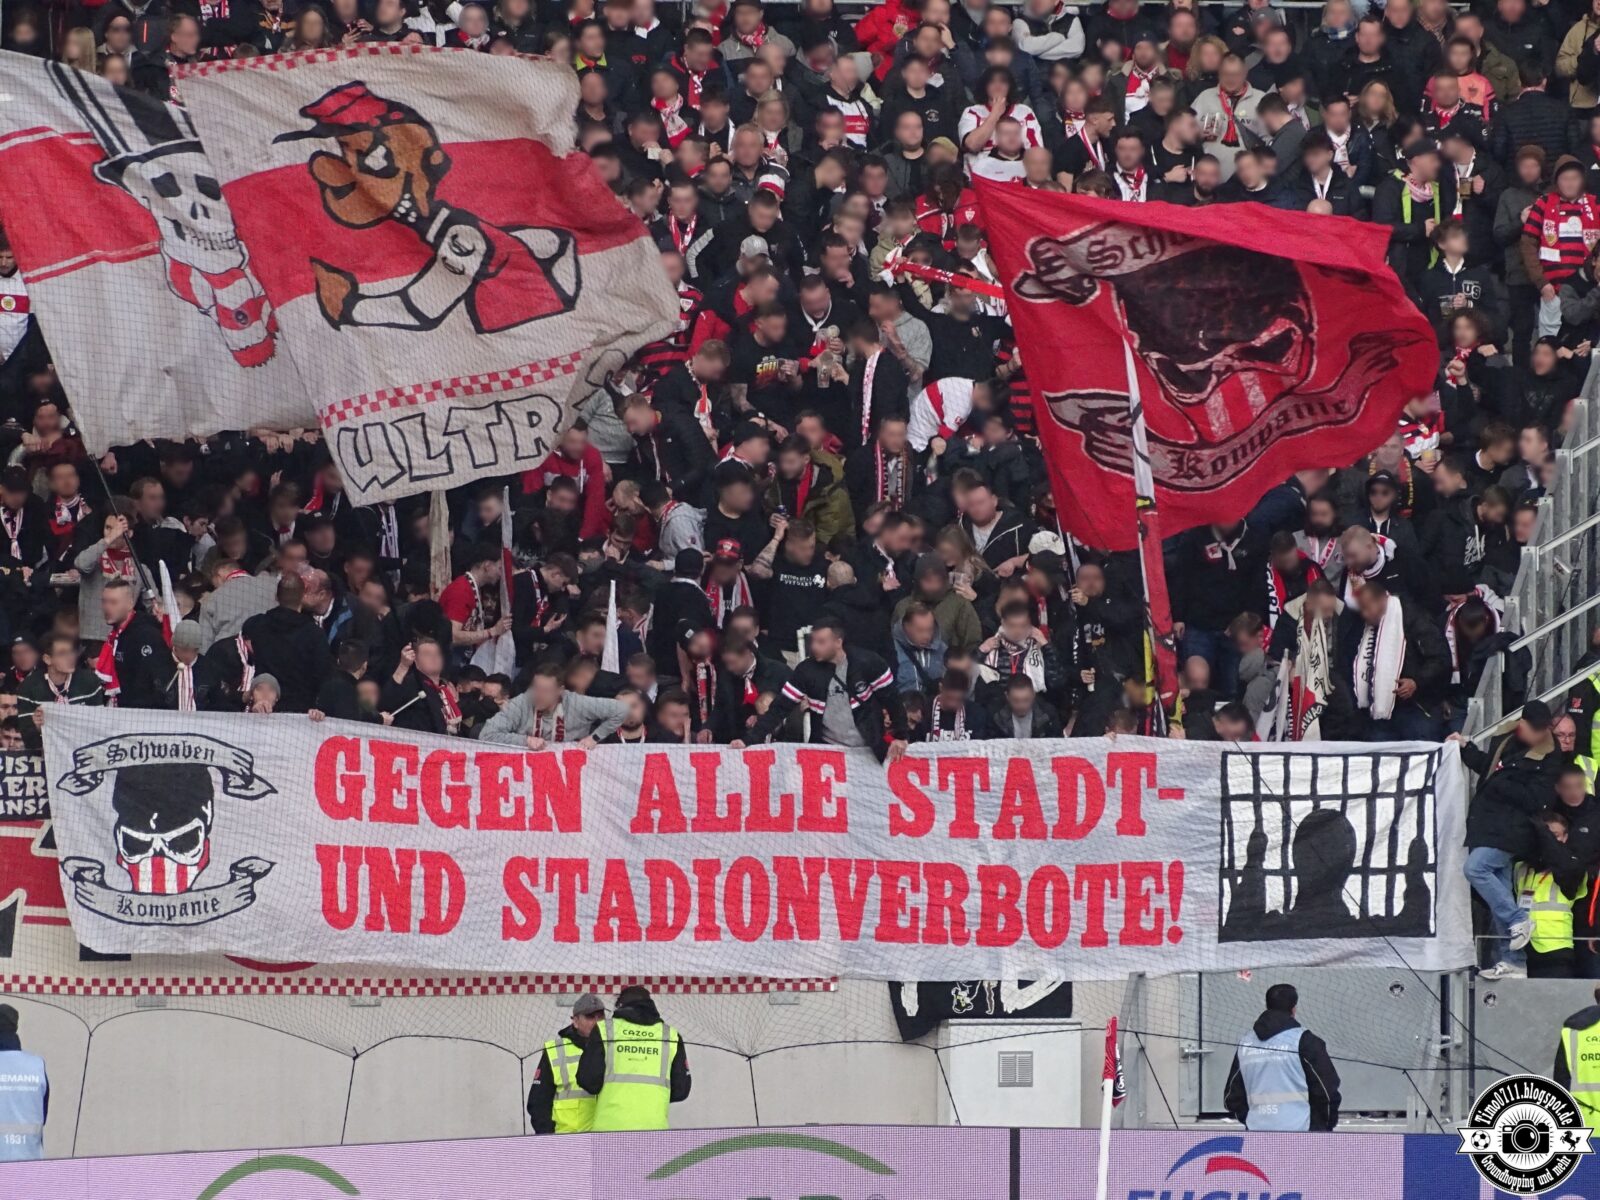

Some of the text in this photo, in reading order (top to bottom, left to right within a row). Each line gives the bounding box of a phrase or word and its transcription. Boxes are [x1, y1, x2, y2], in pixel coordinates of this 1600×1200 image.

[1166, 398, 1349, 482] Kompanie
[0, 755, 45, 775] IST
[106, 740, 215, 764] Schwaben
[314, 735, 1185, 841] GEGEN ALLE STADT-
[116, 894, 221, 922] Kompanie
[314, 842, 1185, 950] UND STADIONVERBOTE!
[622, 1029, 655, 1038] CAZOO
[616, 1044, 659, 1056] ORDNER
